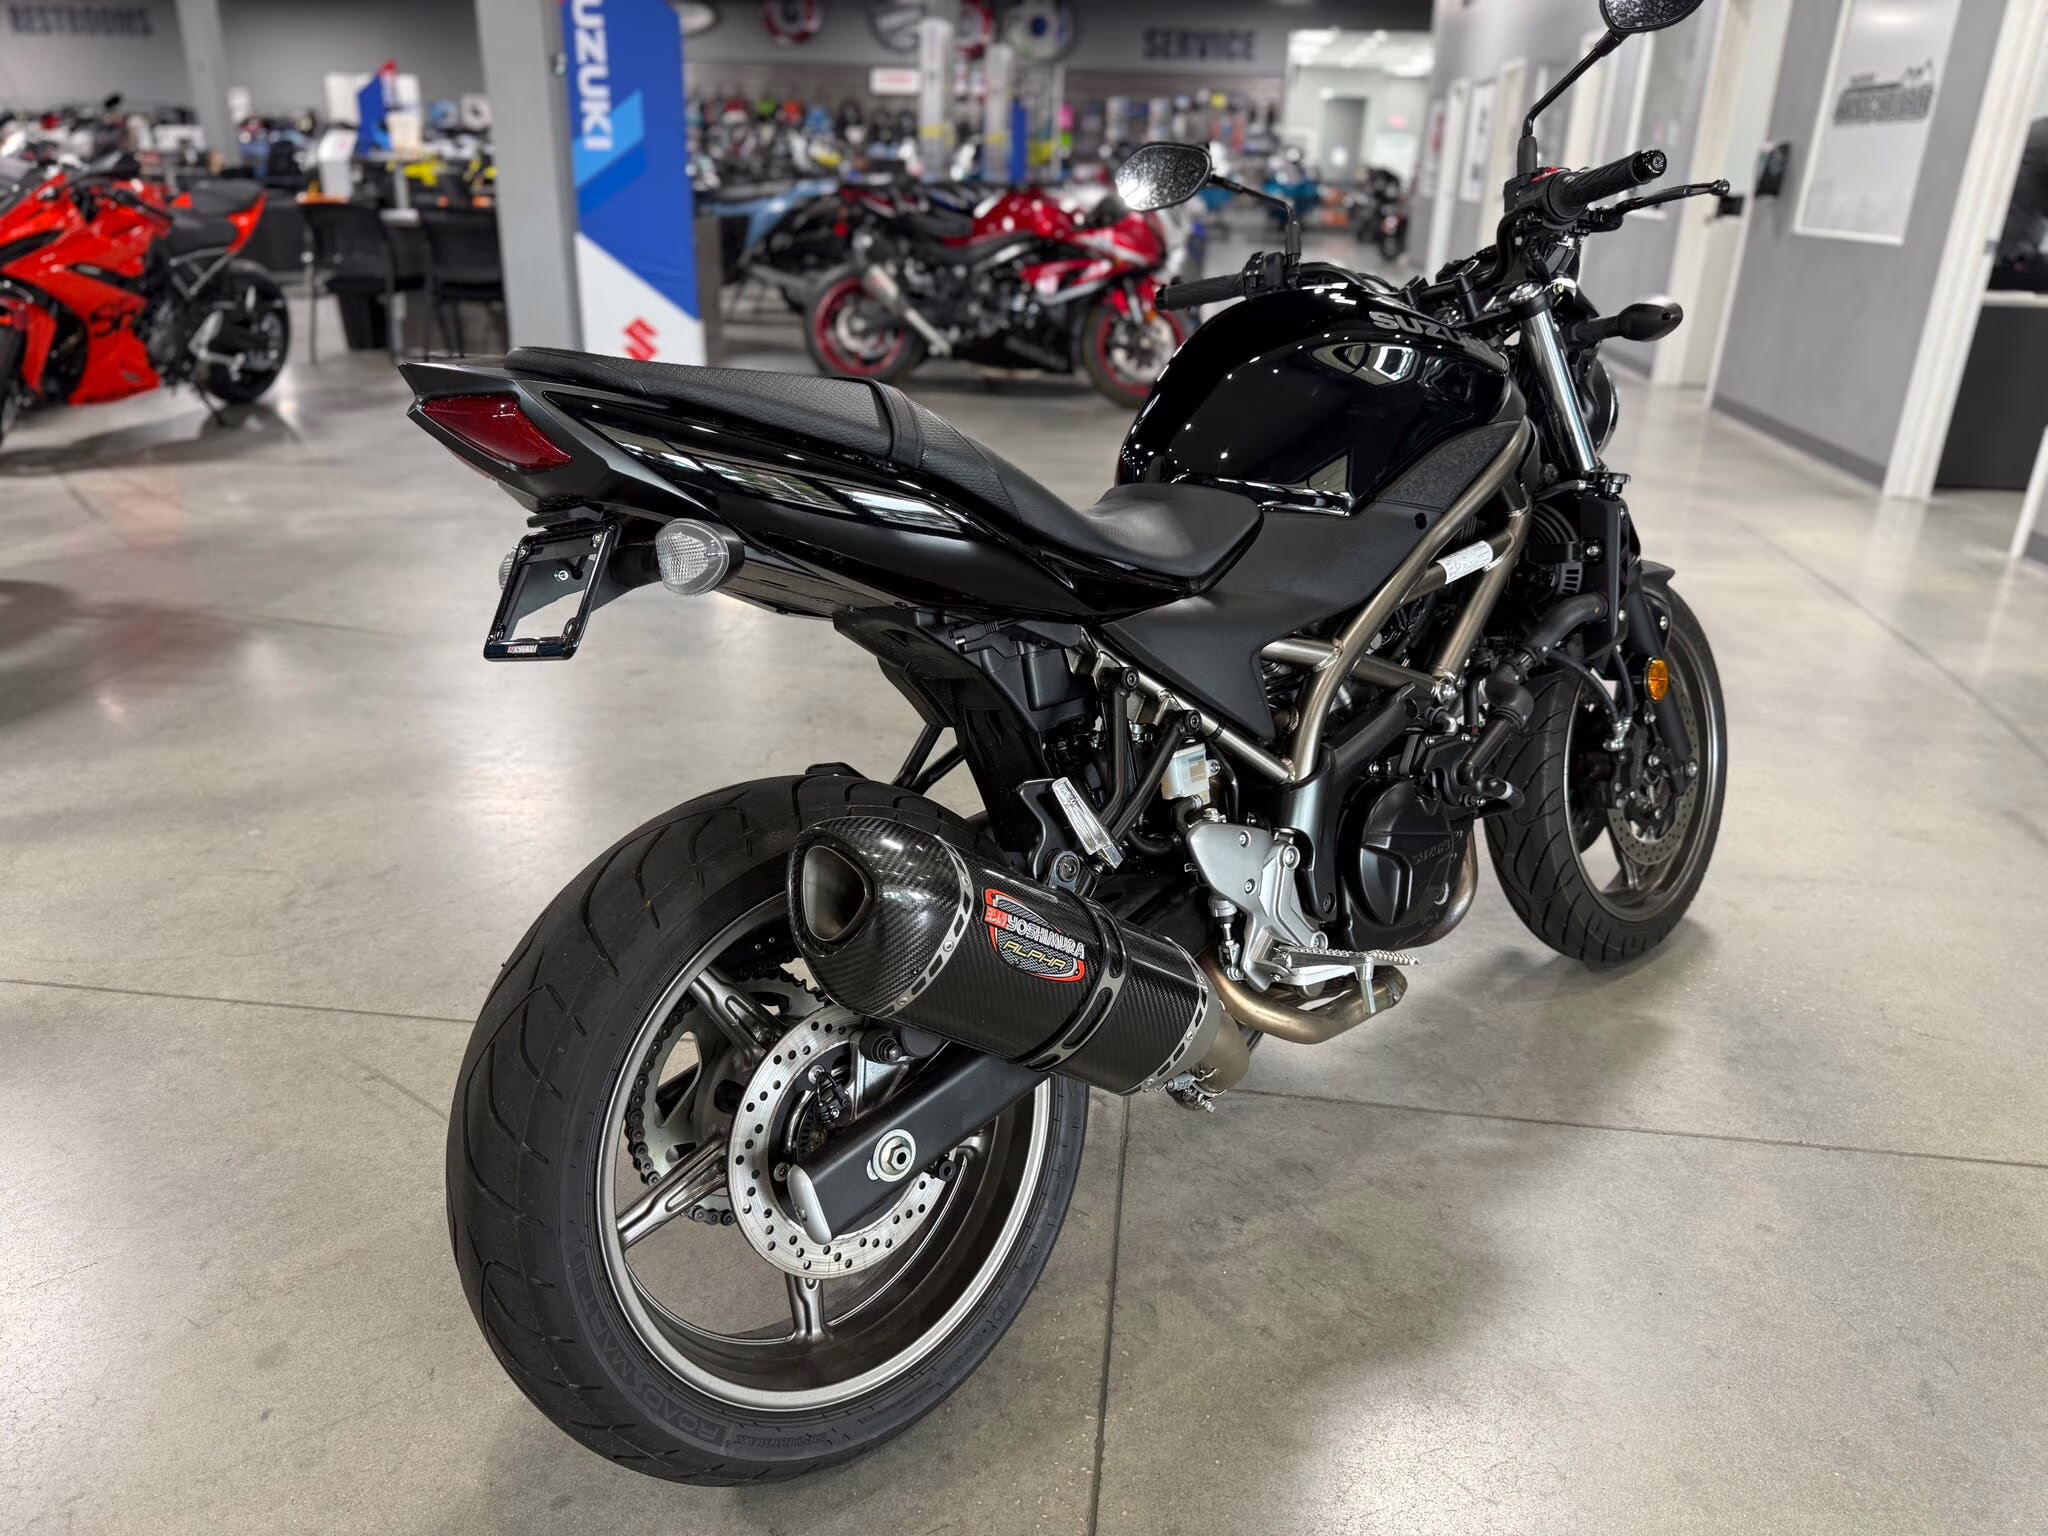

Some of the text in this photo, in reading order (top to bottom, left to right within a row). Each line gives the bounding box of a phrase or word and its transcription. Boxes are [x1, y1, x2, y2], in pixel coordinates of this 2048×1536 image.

[1144, 28, 1256, 62] SERVICE
[1006, 913, 1085, 960] YOSHIMURA
[1003, 940, 1066, 970] ALPHA
